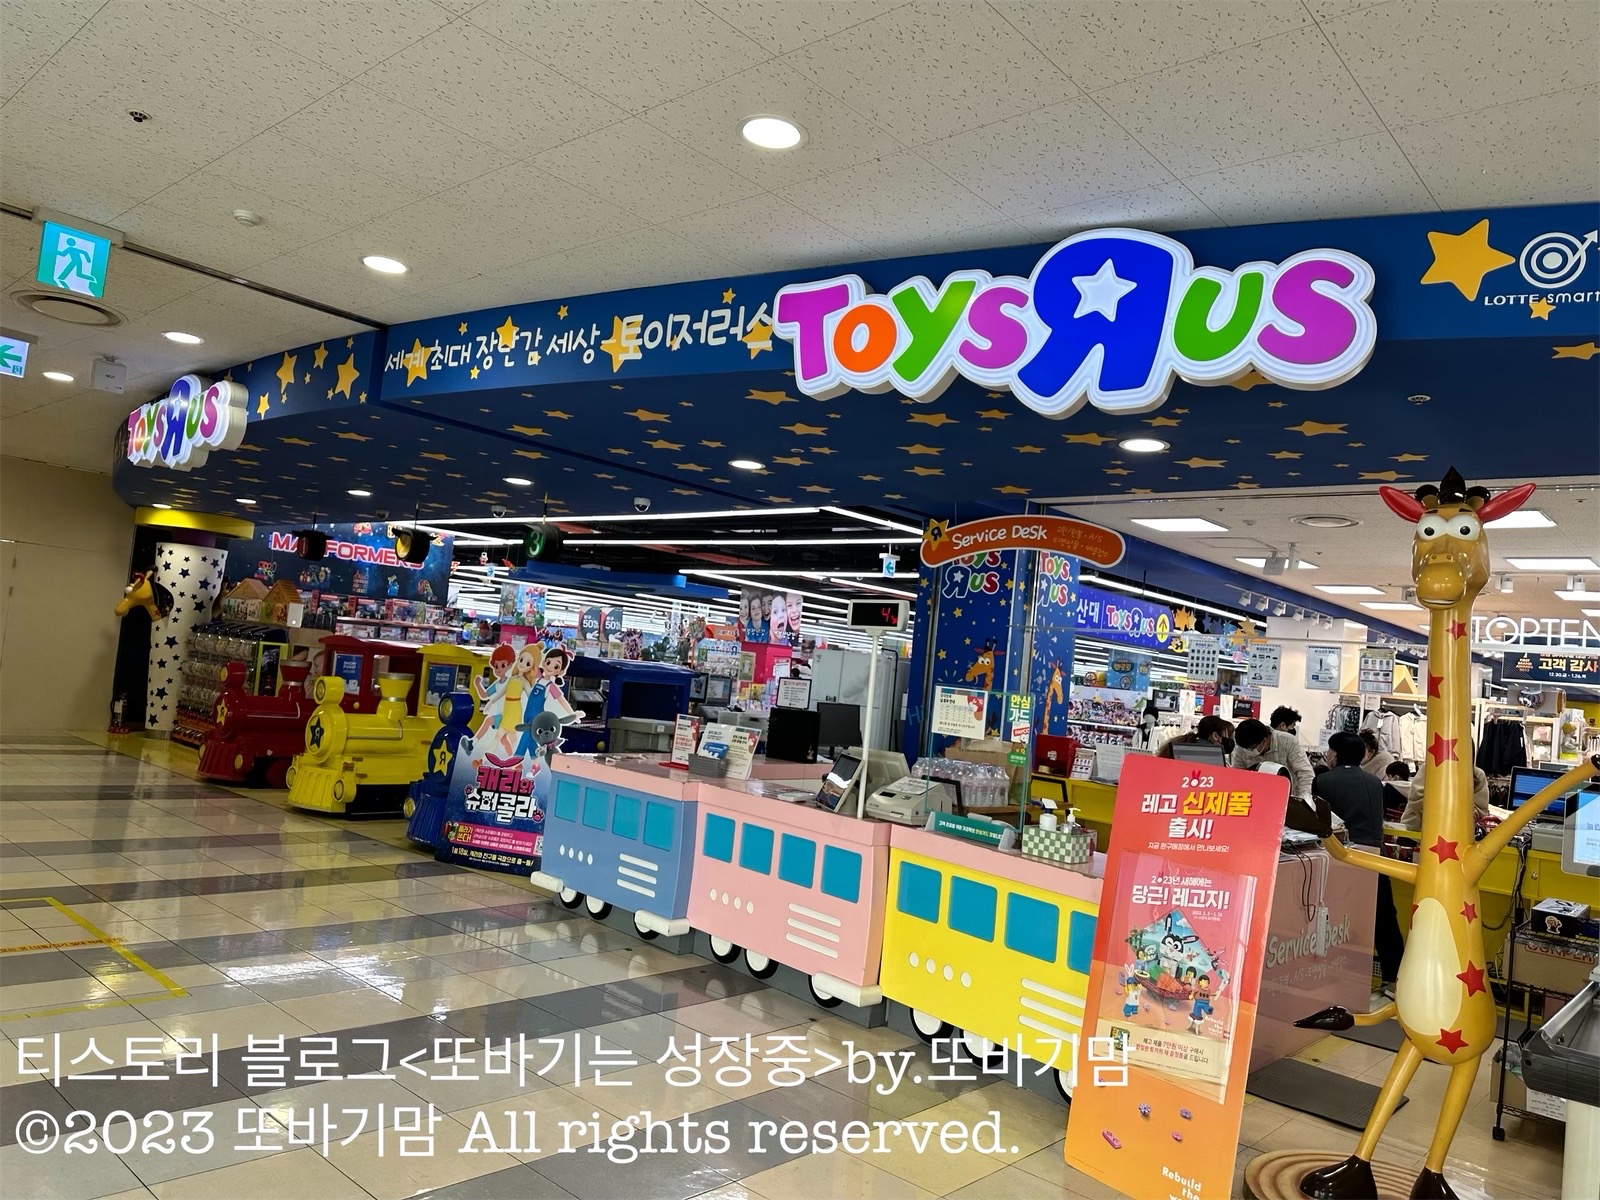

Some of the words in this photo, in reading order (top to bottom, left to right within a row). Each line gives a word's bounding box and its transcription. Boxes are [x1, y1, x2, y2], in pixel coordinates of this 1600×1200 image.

[1484, 293, 1539, 306] LOTTE
[385, 348, 425, 372] 세계
[431, 339, 472, 370] 최대
[475, 326, 544, 370] 장난감
[546, 322, 601, 364] 세상
[619, 302, 774, 360] 토이저러스
[1538, 658, 1566, 671] 고객
[1570, 659, 1598, 673] 감사
[1010, 694, 1030, 709] 안심
[476, 766, 536, 794] 캐리와
[465, 788, 537, 823] 슈퍼콜라
[1141, 794, 1178, 814] 레고
[1183, 791, 1252, 817] 신제품
[1168, 817, 1214, 839] 출시!
[1131, 885, 1169, 905] 당근!
[1172, 889, 1230, 910] 레고지!
[1266, 928, 1317, 969] Service
[1162, 1166, 1201, 1191] Rebuild
[1182, 1188, 1200, 1200] the
